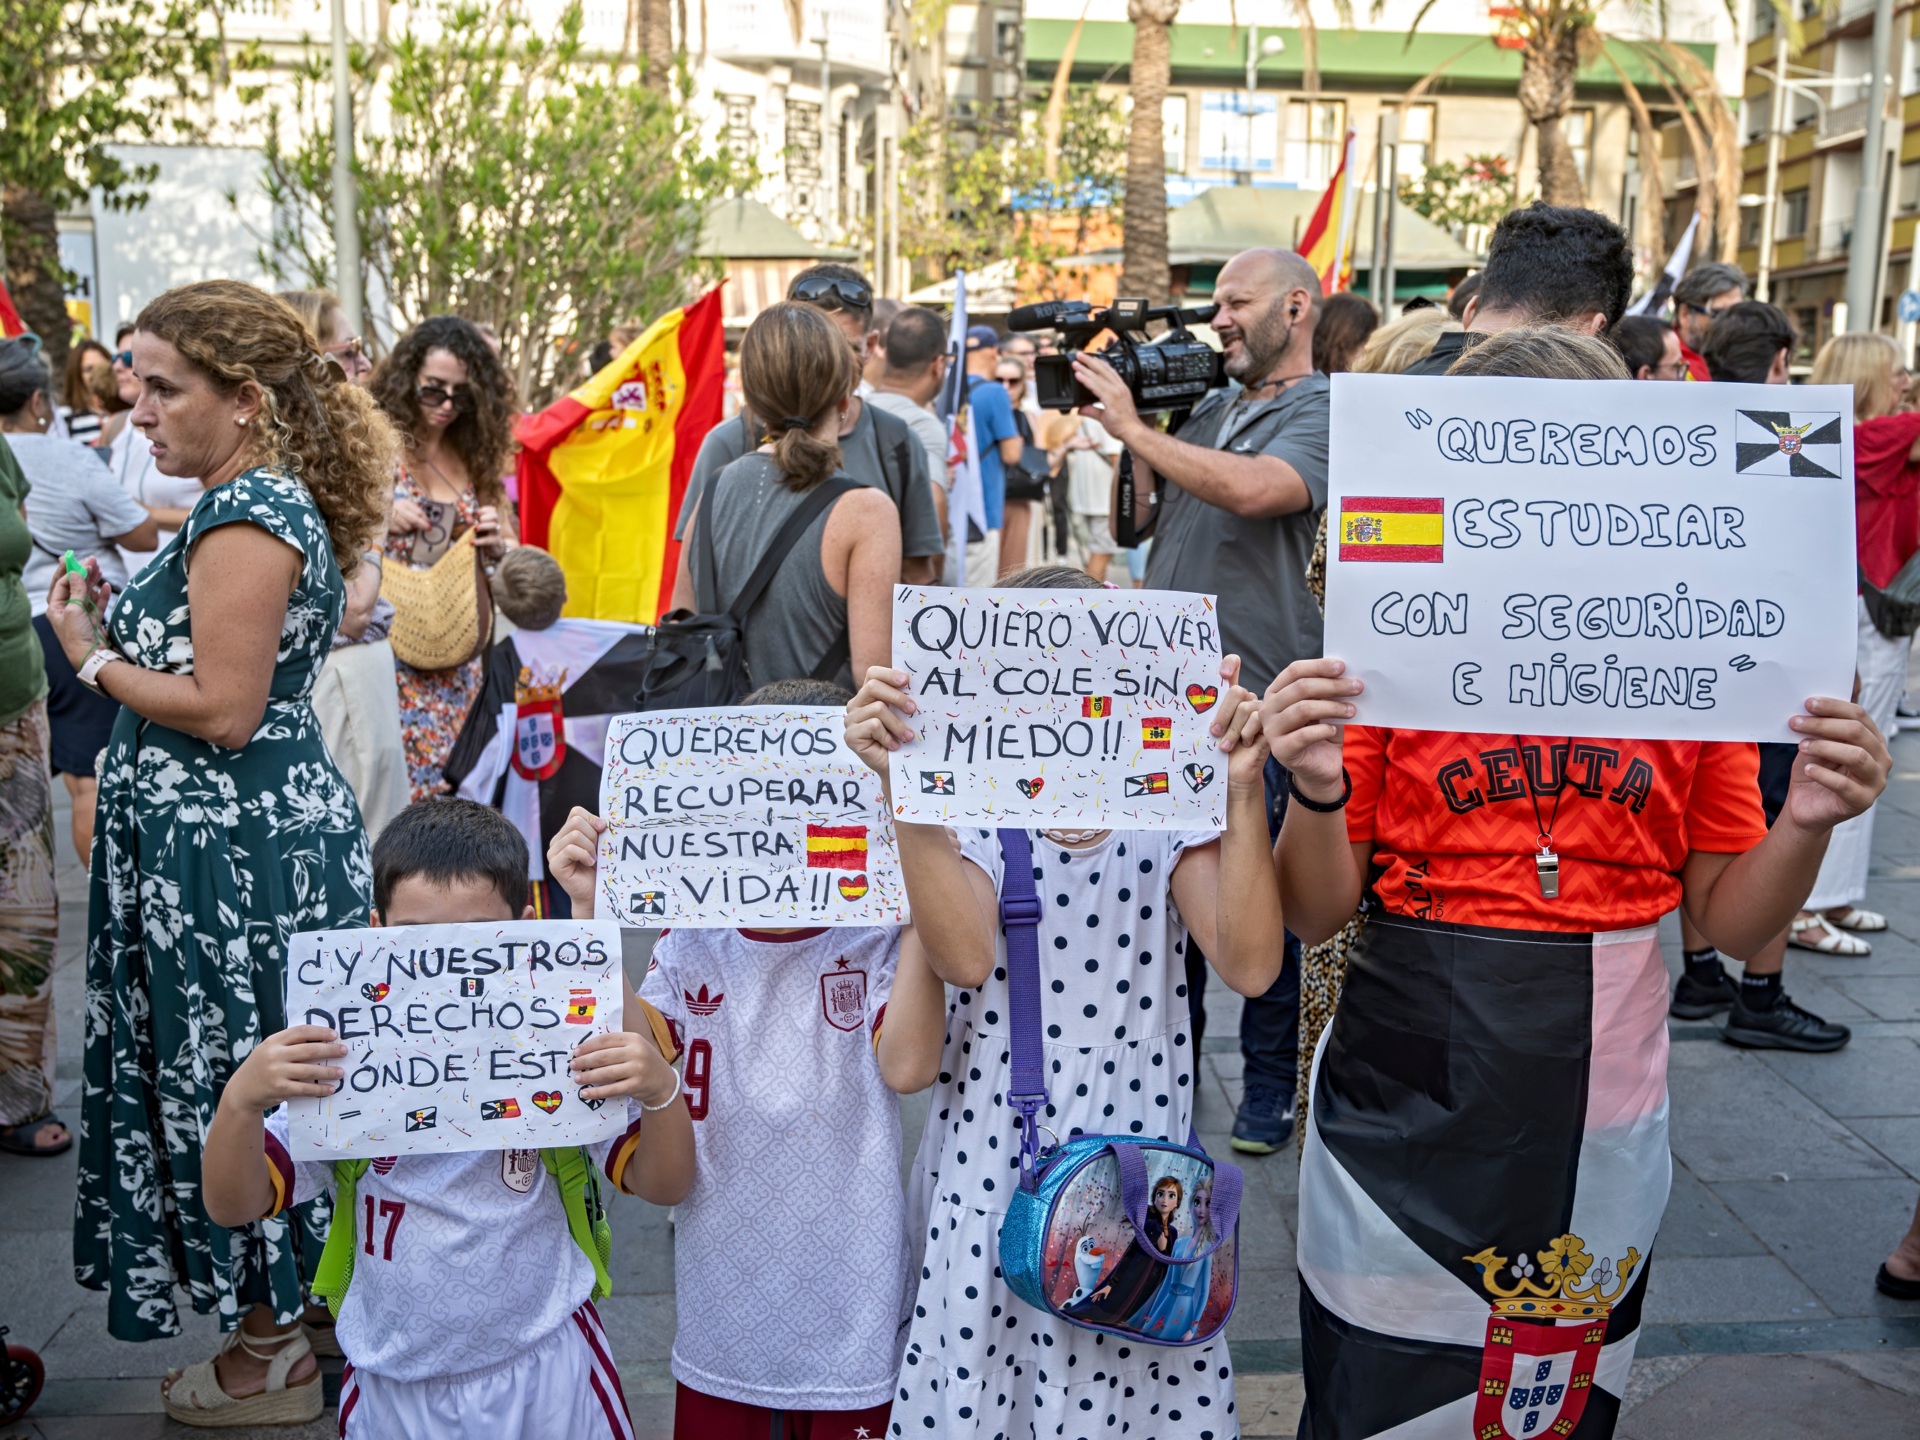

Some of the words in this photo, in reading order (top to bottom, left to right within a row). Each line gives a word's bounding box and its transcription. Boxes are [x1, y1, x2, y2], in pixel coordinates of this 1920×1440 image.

[1453, 499, 1746, 549] ESTUDIAR
[1089, 609, 1218, 654] VOLVER
[1371, 592, 1468, 637] CON
[920, 666, 977, 697] AL
[993, 667, 1092, 697] COLE
[1452, 661, 1483, 706] E
[620, 726, 837, 769] QUEREMOS
[624, 777, 867, 819] RECUPERAR
[1436, 743, 1653, 815] CEUTA
[621, 830, 793, 862] NUESTRA
[386, 939, 609, 986] NUESTROS
[304, 997, 561, 1043] DERECHOS
[489, 1031, 594, 1081] EST
[683, 1038, 713, 1121] 9
[364, 1194, 406, 1262] 17
